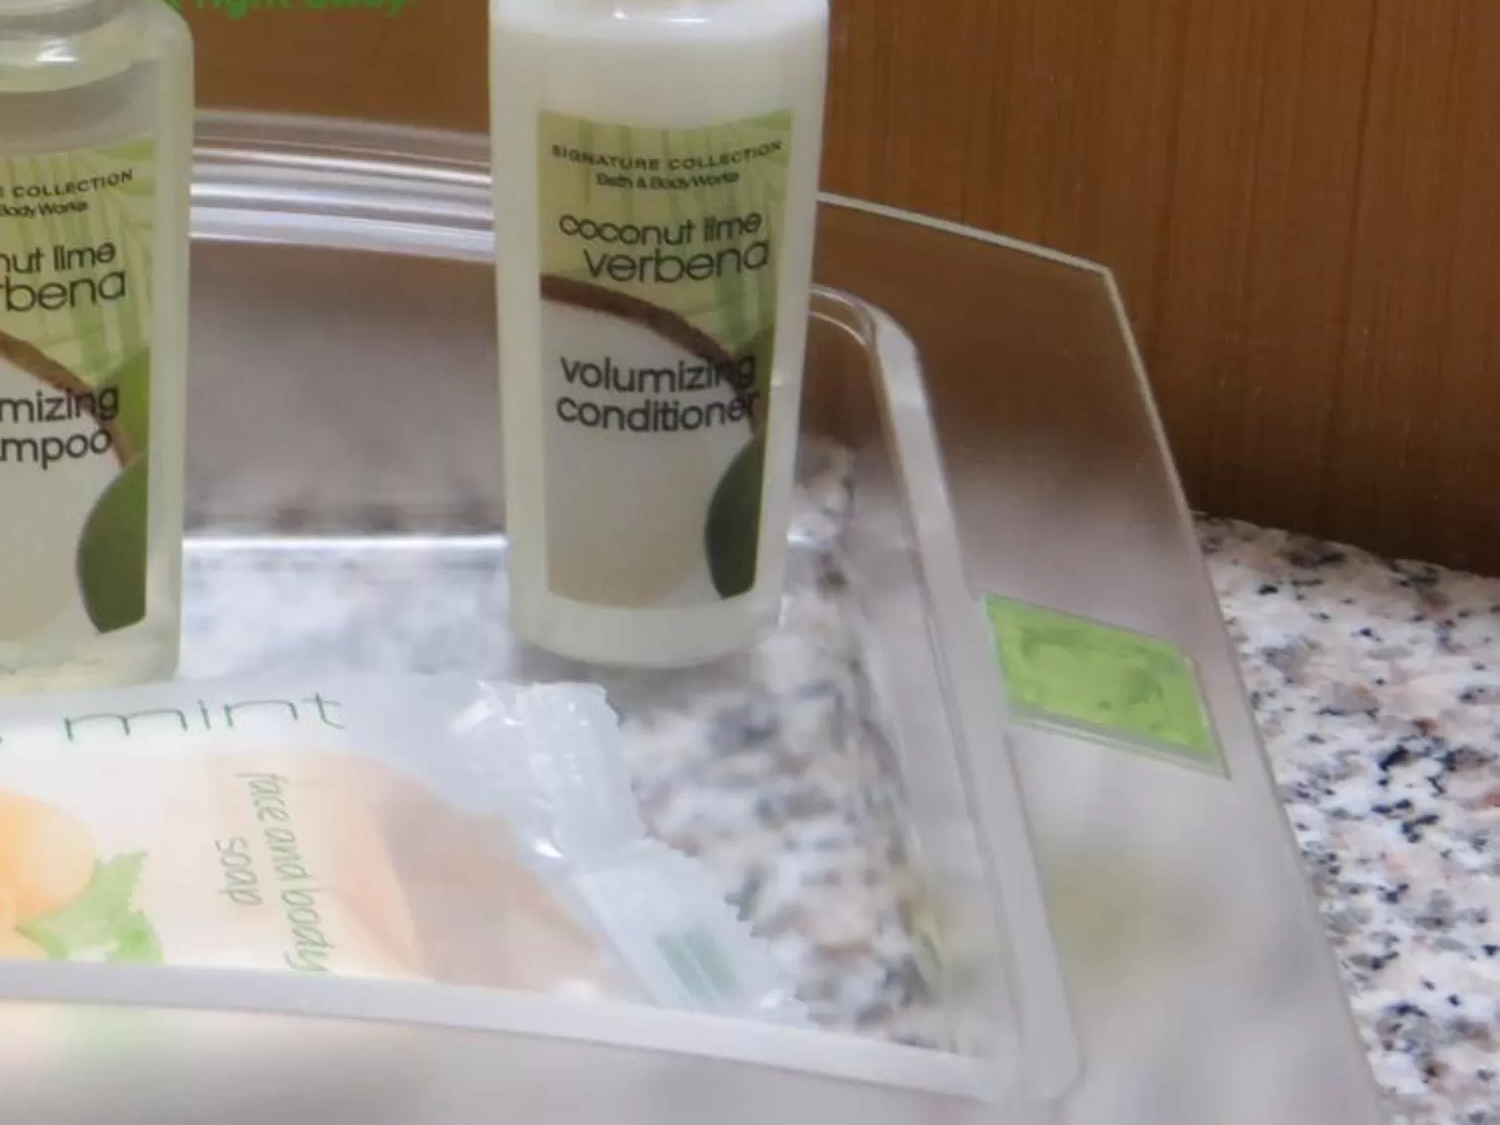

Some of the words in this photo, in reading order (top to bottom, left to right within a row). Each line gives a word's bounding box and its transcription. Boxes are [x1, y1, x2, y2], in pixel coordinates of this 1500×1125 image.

[551, 143, 660, 172] SIGNATURE
[667, 138, 783, 171] COLLECTION
[12, 168, 134, 198] COLLECTION
[595, 171, 634, 190] Bath
[38, 199, 90, 216] Works
[558, 213, 695, 247] coconut
[702, 211, 762, 243] lime
[53, 241, 117, 271] lime
[582, 240, 770, 284] verbena
[559, 352, 758, 395] volumizing
[555, 390, 761, 433] conditioner
[62, 692, 348, 742] mint
[234, 771, 293, 823] face
[211, 834, 264, 908] soap
[262, 826, 319, 882] and
[282, 884, 338, 973] body
